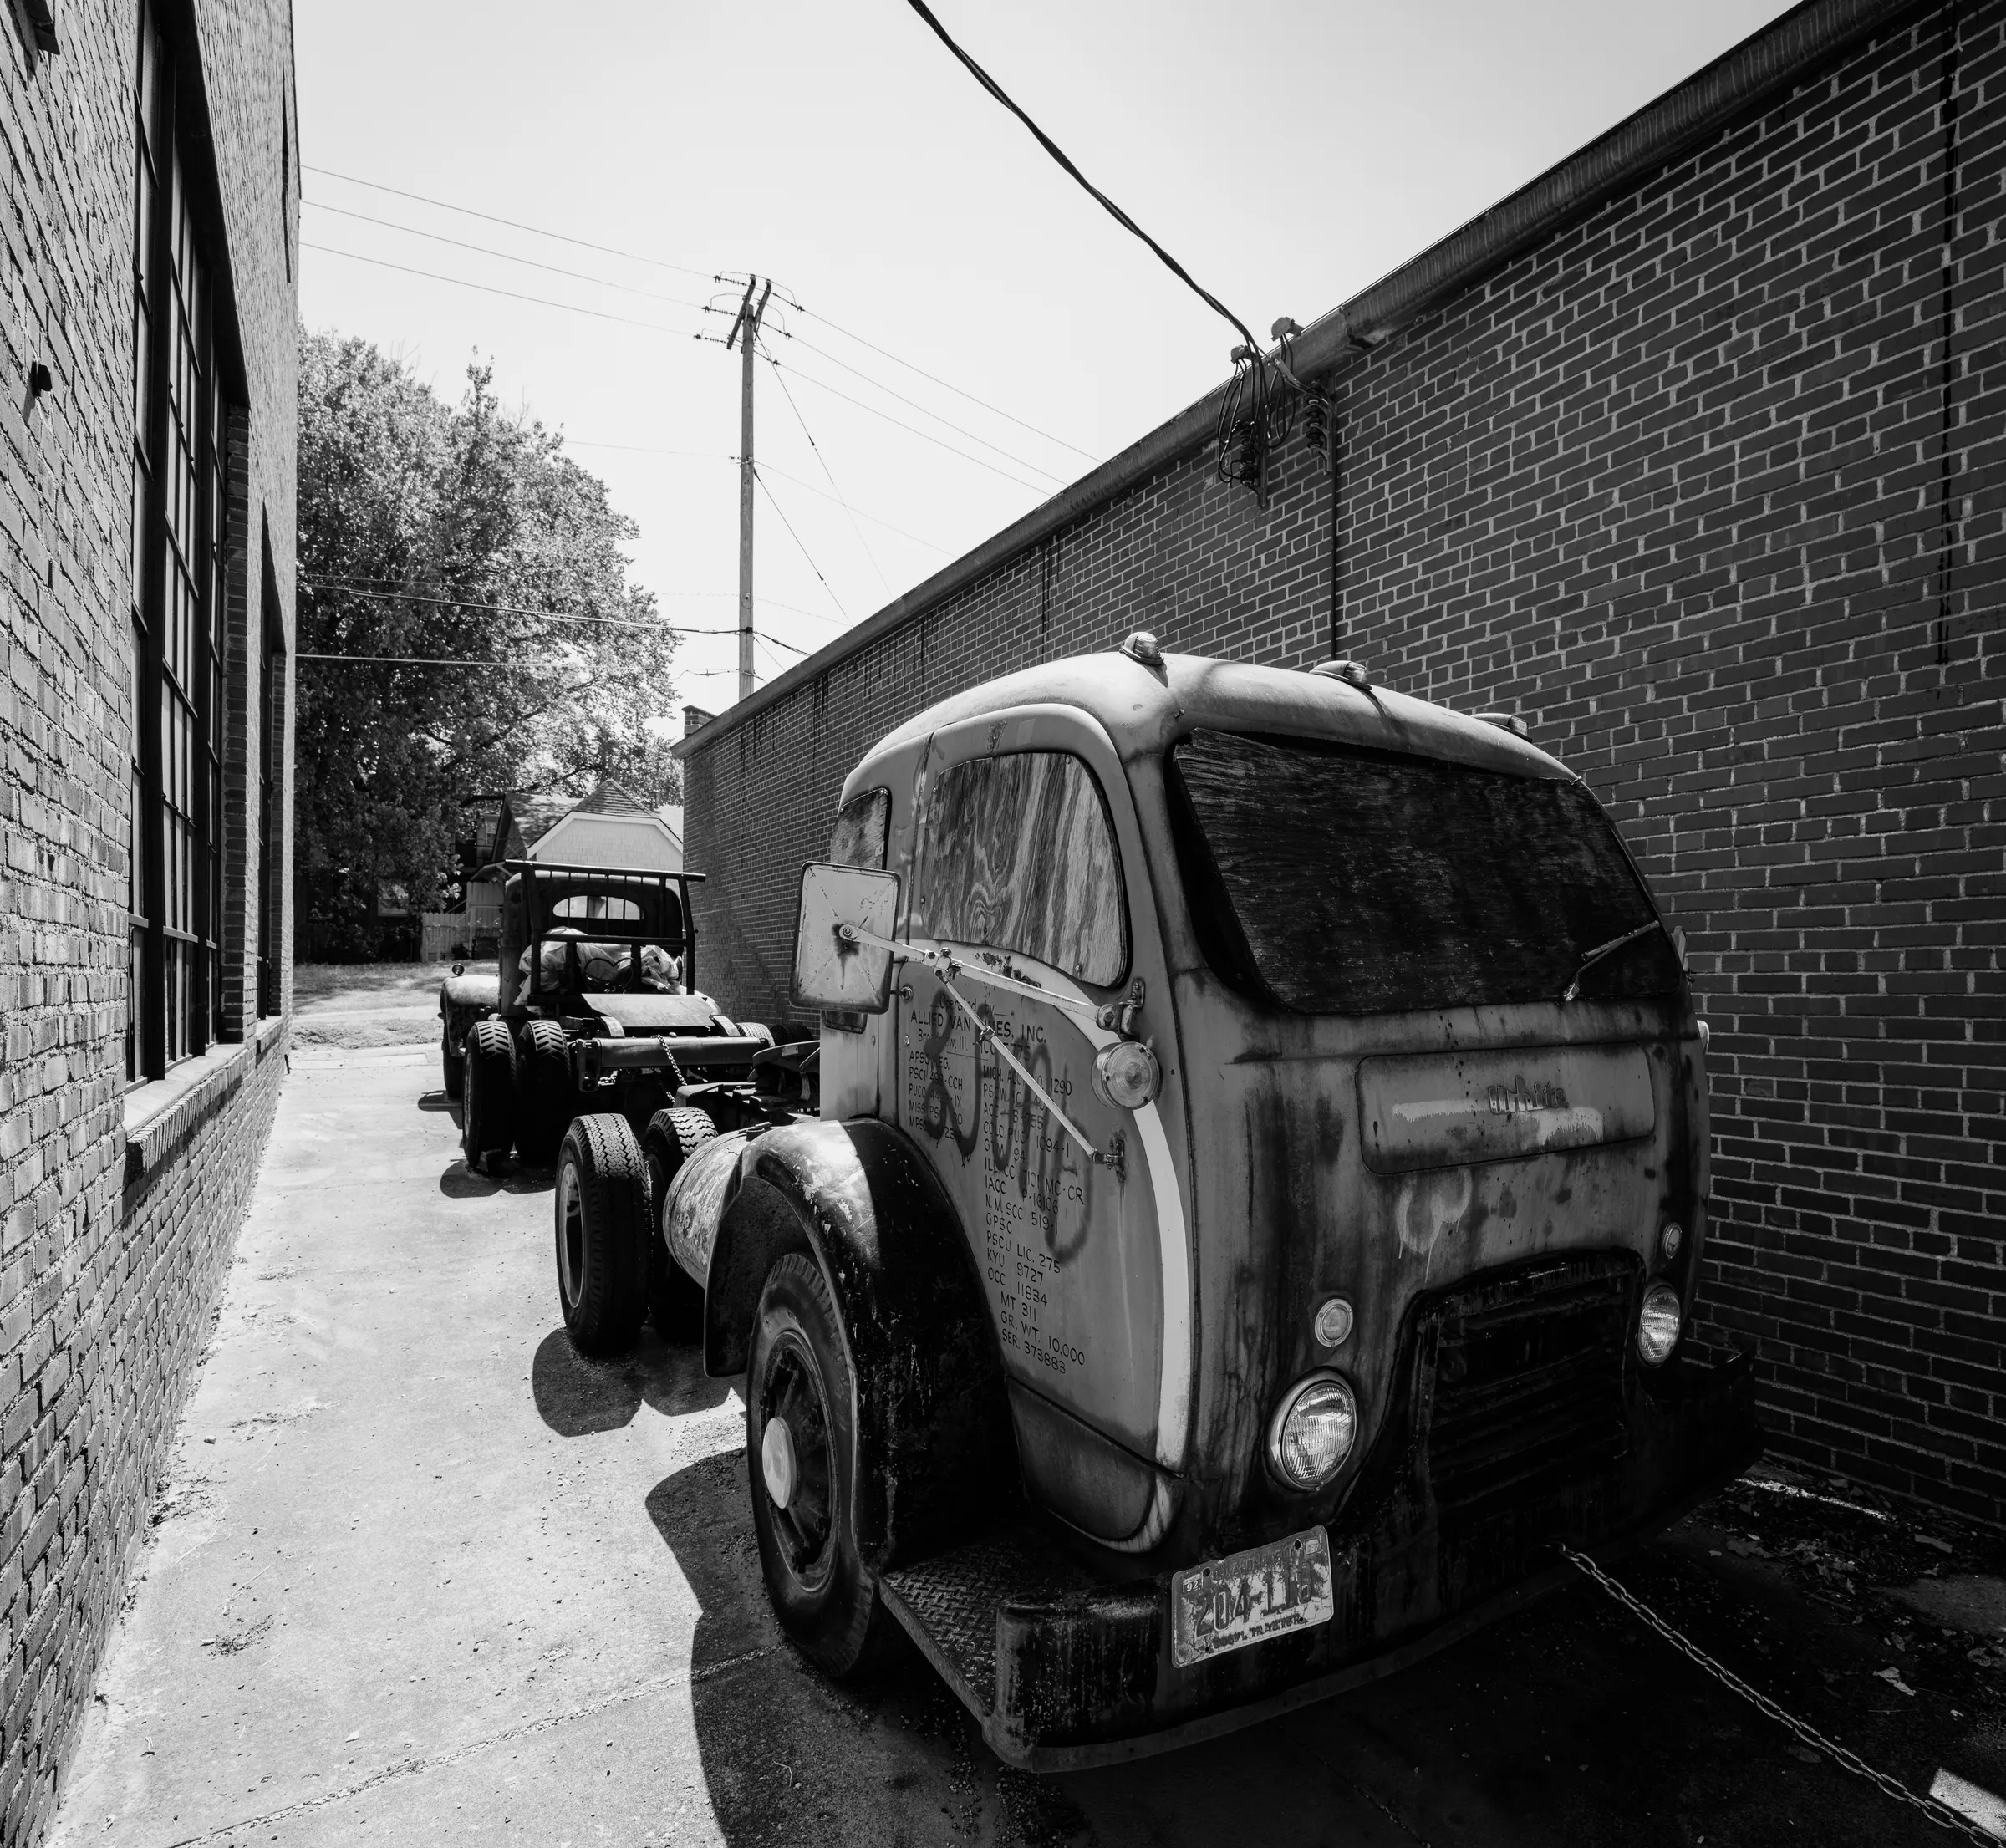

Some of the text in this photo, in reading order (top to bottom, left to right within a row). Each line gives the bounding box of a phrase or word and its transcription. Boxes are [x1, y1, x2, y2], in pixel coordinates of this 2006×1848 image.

[909, 1009, 944, 1026] ALLIED
[949, 1016, 971, 1032] VAN
[1021, 1023, 1046, 1043] INC.
[909, 1067, 926, 1081] PSCI
[932, 1055, 950, 1070] EG.
[983, 1065, 1004, 1082] MICH.
[1051, 1077, 1072, 1096] 1290
[1037, 1135, 1069, 1158] 1094-1
[985, 1174, 1006, 1194] IACC
[1004, 1163, 1016, 1179] CC
[985, 1212, 1013, 1234] GPSC
[1006, 1202, 1023, 1220] SCC
[986, 1229, 1061, 1274] PSCU LIC. 275
[987, 1247, 1043, 1286] KYU 9727
[987, 1266, 1048, 1307] OCC 11834
[1000, 1291, 1036, 1322] MT 311
[1000, 1311, 1085, 1366] GR. WT. 10,000
[1001, 1328, 1067, 1374] SER. 373883
